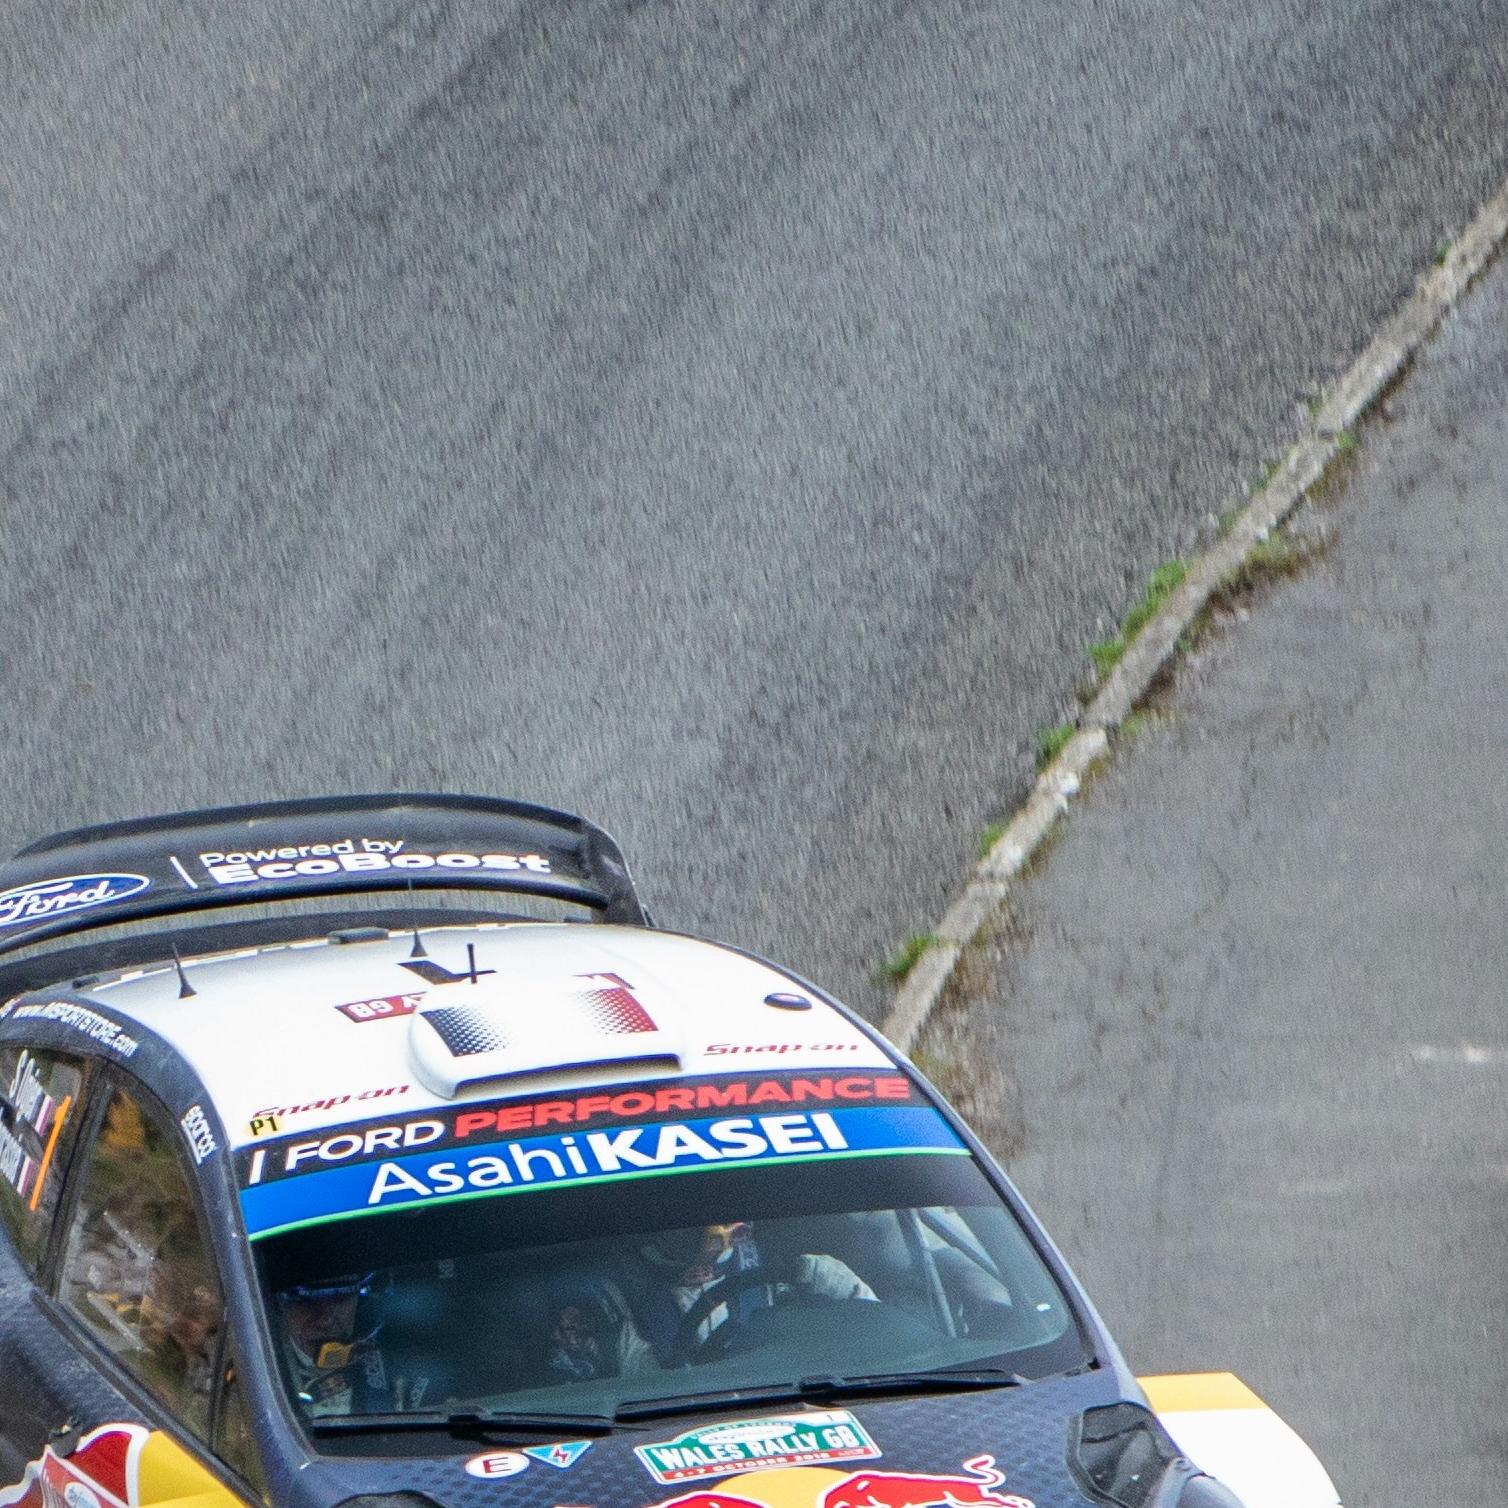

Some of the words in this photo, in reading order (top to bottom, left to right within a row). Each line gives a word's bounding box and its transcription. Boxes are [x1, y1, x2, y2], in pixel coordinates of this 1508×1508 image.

[200, 842, 352, 868] Powered
[361, 838, 404, 854] by
[208, 853, 552, 884] EcoBoost
[248, 1115, 278, 1137] P1
[285, 1119, 446, 1173] FORD
[453, 1077, 910, 1138] PERFORMANCE
[650, 1442, 746, 1471] WALES
[744, 1431, 821, 1457] RALLY
[821, 1424, 860, 1449] GB
[482, 1456, 512, 1474] E
[713, 1457, 787, 1473] OCTOBER
